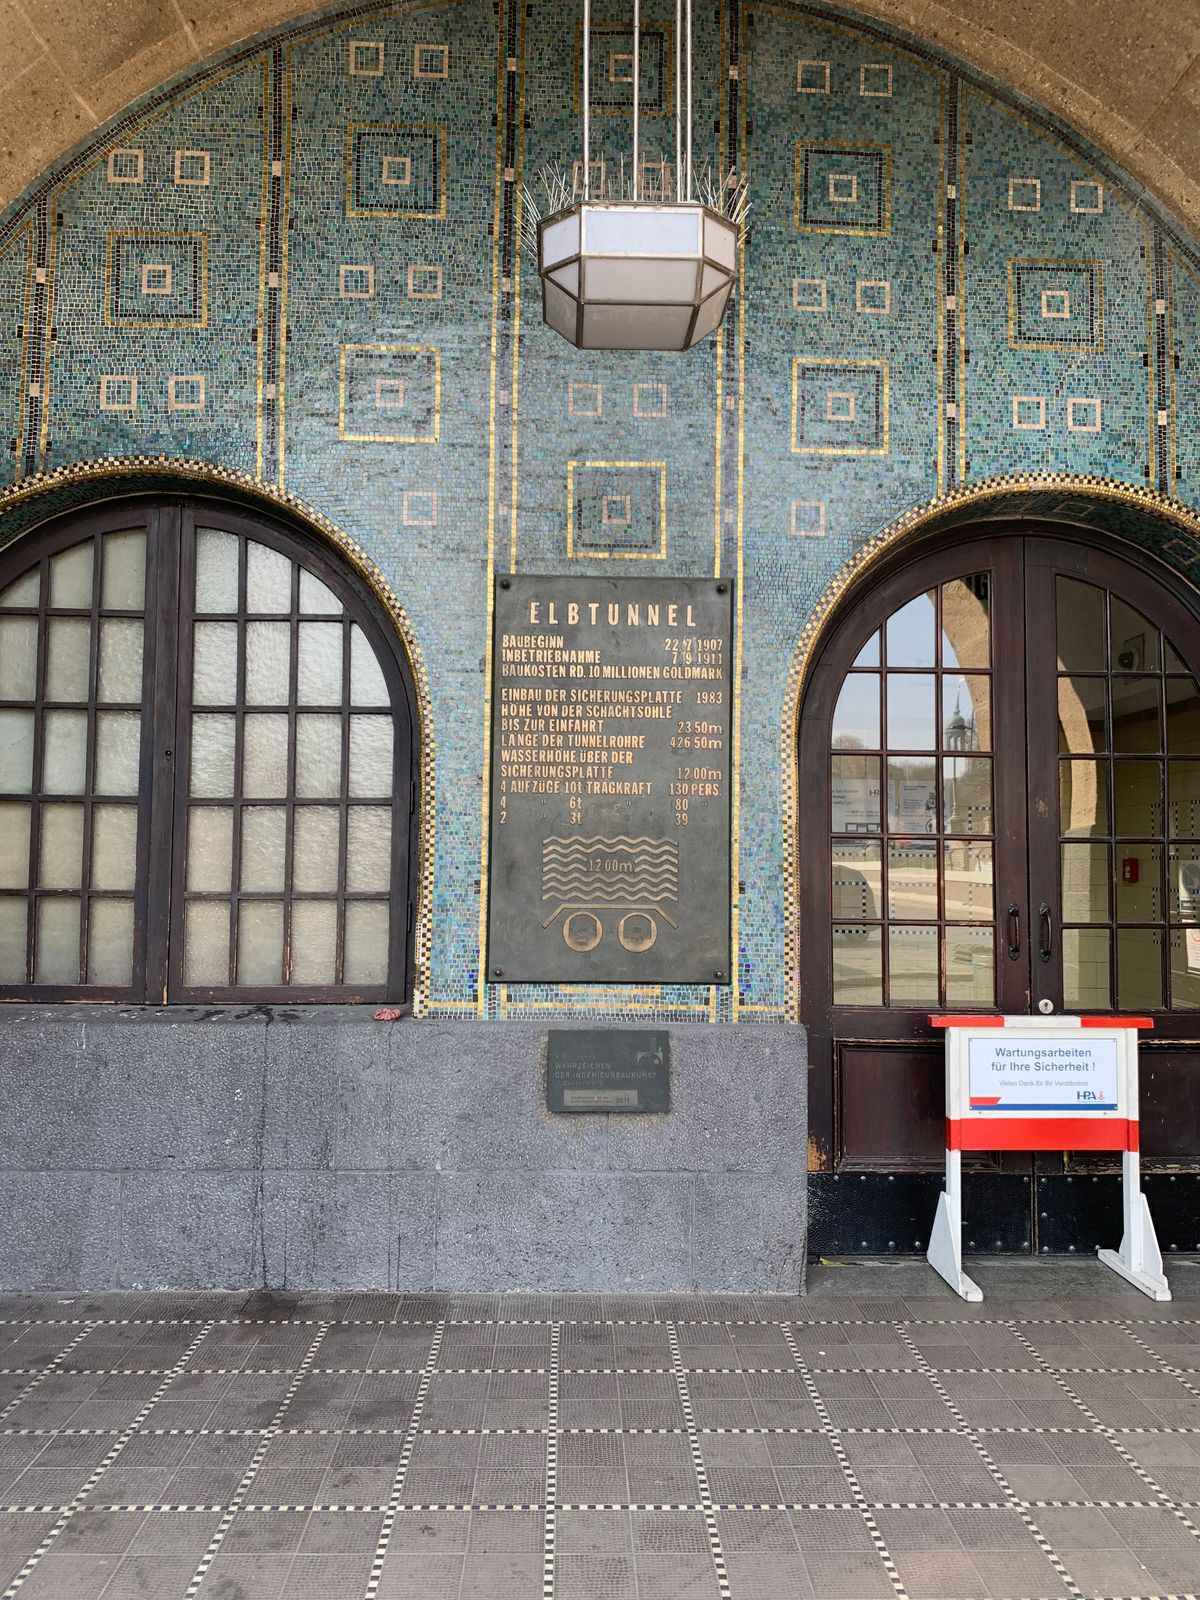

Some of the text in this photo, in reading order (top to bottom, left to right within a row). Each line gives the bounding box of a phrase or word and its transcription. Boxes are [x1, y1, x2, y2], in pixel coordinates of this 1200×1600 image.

[530, 602, 696, 627] ELBTUNNEL
[502, 634, 564, 649] BAUBEGINN
[502, 649, 601, 663] INBETRIEBNAHME
[502, 664, 722, 679] BAUKOSTEN RD. 10 MILLIONEN GOLDMARK
[502, 688, 722, 704] EINBAU DER SICHERUNGSPLATTE 1983
[501, 702, 672, 719] HÖHE VON DER SCHACHTSOHLE
[501, 718, 520, 731] BIS
[523, 719, 545, 731] ZUR
[549, 719, 604, 733] EINFAHRT
[501, 732, 538, 747] LÄNGE
[542, 734, 563, 747] DER
[568, 734, 645, 748] TUNNELROHRE
[501, 748, 576, 763] WASSERHÖHE
[611, 751, 633, 764] DER
[501, 764, 613, 778] SICHERUNGSPLATTE
[500, 780, 506, 793] 4
[564, 781, 583, 794] 10t
[586, 781, 652, 795] TRAGKRAFT
[669, 783, 688, 795] 130
[691, 783, 722, 796] PERS.
[500, 796, 506, 809] 4
[569, 796, 583, 809] 6t
[675, 798, 688, 811] 80
[500, 811, 507, 824] 2
[570, 812, 582, 825] 3t
[675, 813, 688, 826] 39
[995, 1047, 1092, 1060] Wartungsarbeiten
[555, 1062, 611, 1070] WAHRZEICHEN
[991, 1061, 1006, 1071] für
[1010, 1061, 1031, 1071] Ihre
[1034, 1061, 1089, 1072] Sicherheit
[555, 1071, 569, 1079] DER
[1076, 1090, 1097, 1100] HPA
